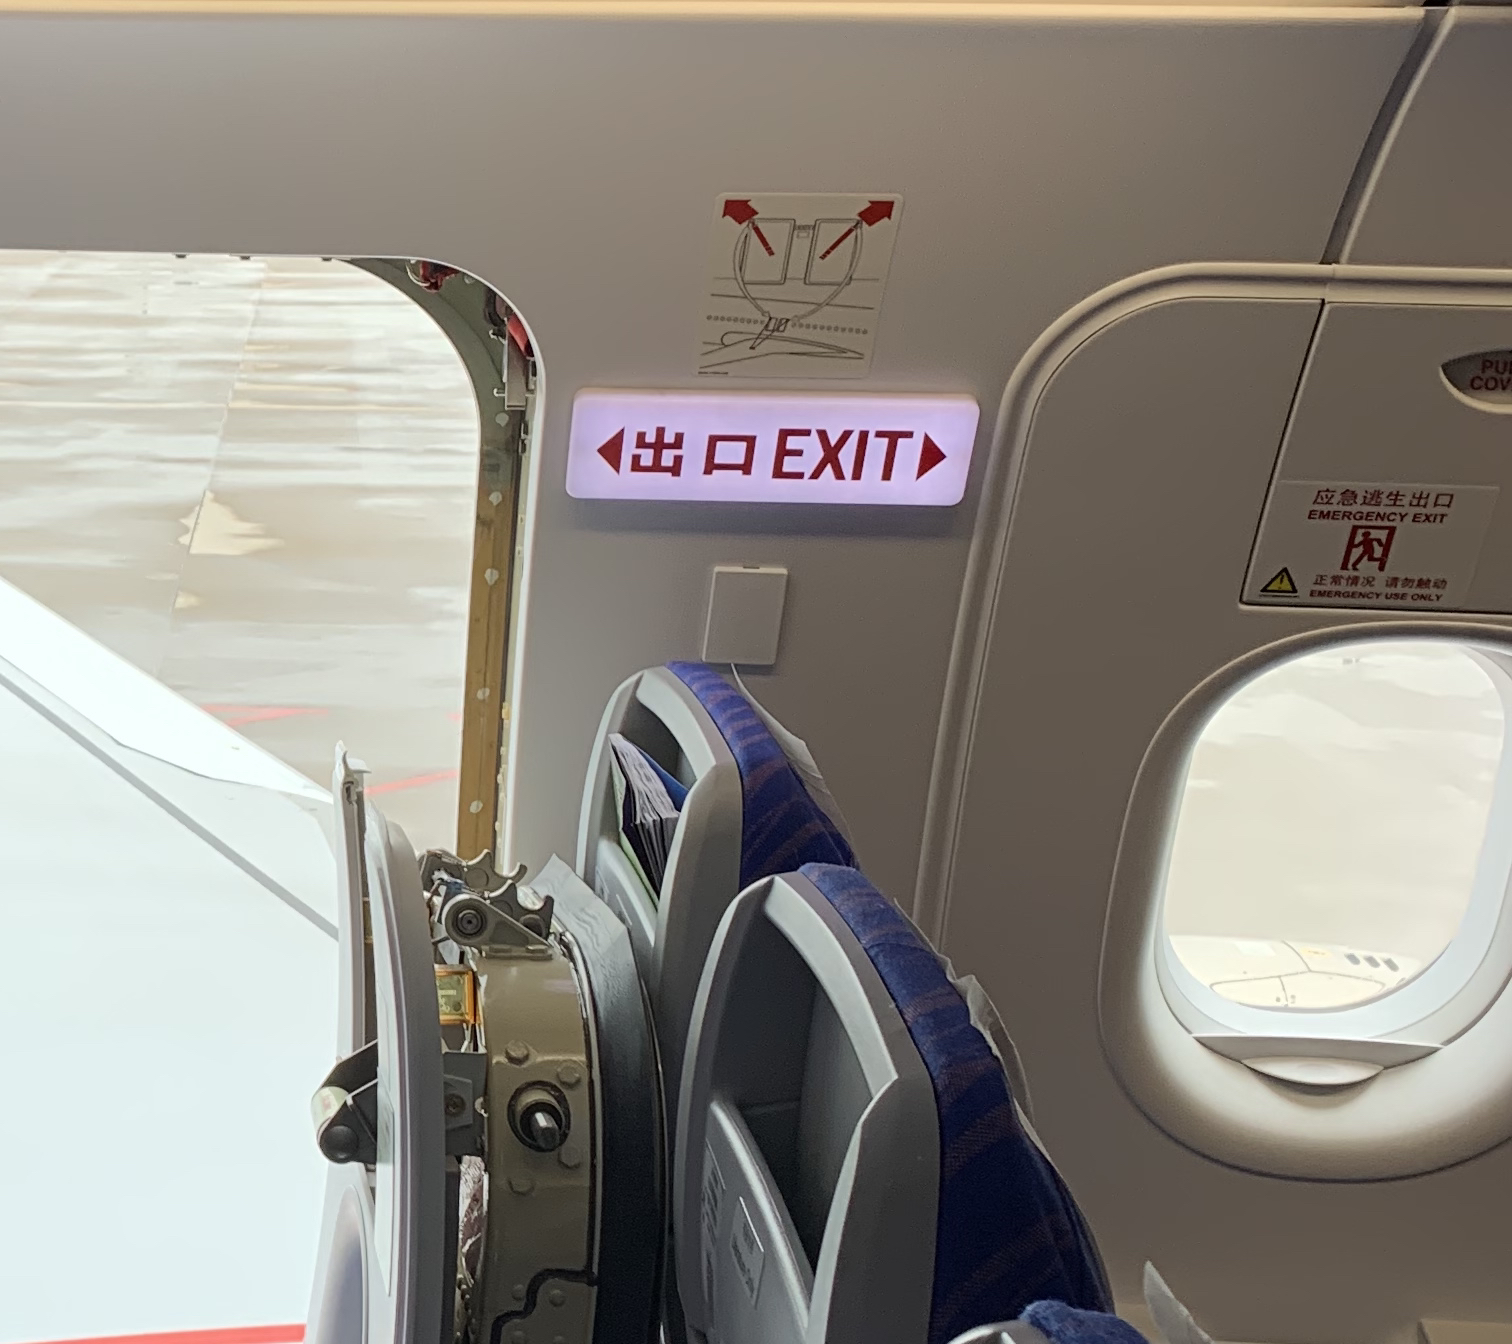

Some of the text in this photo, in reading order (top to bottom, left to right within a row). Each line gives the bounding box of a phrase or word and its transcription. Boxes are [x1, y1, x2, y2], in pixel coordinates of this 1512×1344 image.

[1469, 376, 1512, 391] COV
[629, 426, 915, 482] 出口 EXIT
[1311, 488, 1455, 509] 应急逃生出口
[1307, 509, 1448, 524] EMERGENCY EXIT
[1312, 574, 1448, 590] 正常情况 请勿触动
[1309, 590, 1382, 600] EMERGENCY
[1384, 592, 1409, 601] USE
[1410, 593, 1444, 602] ONLY
